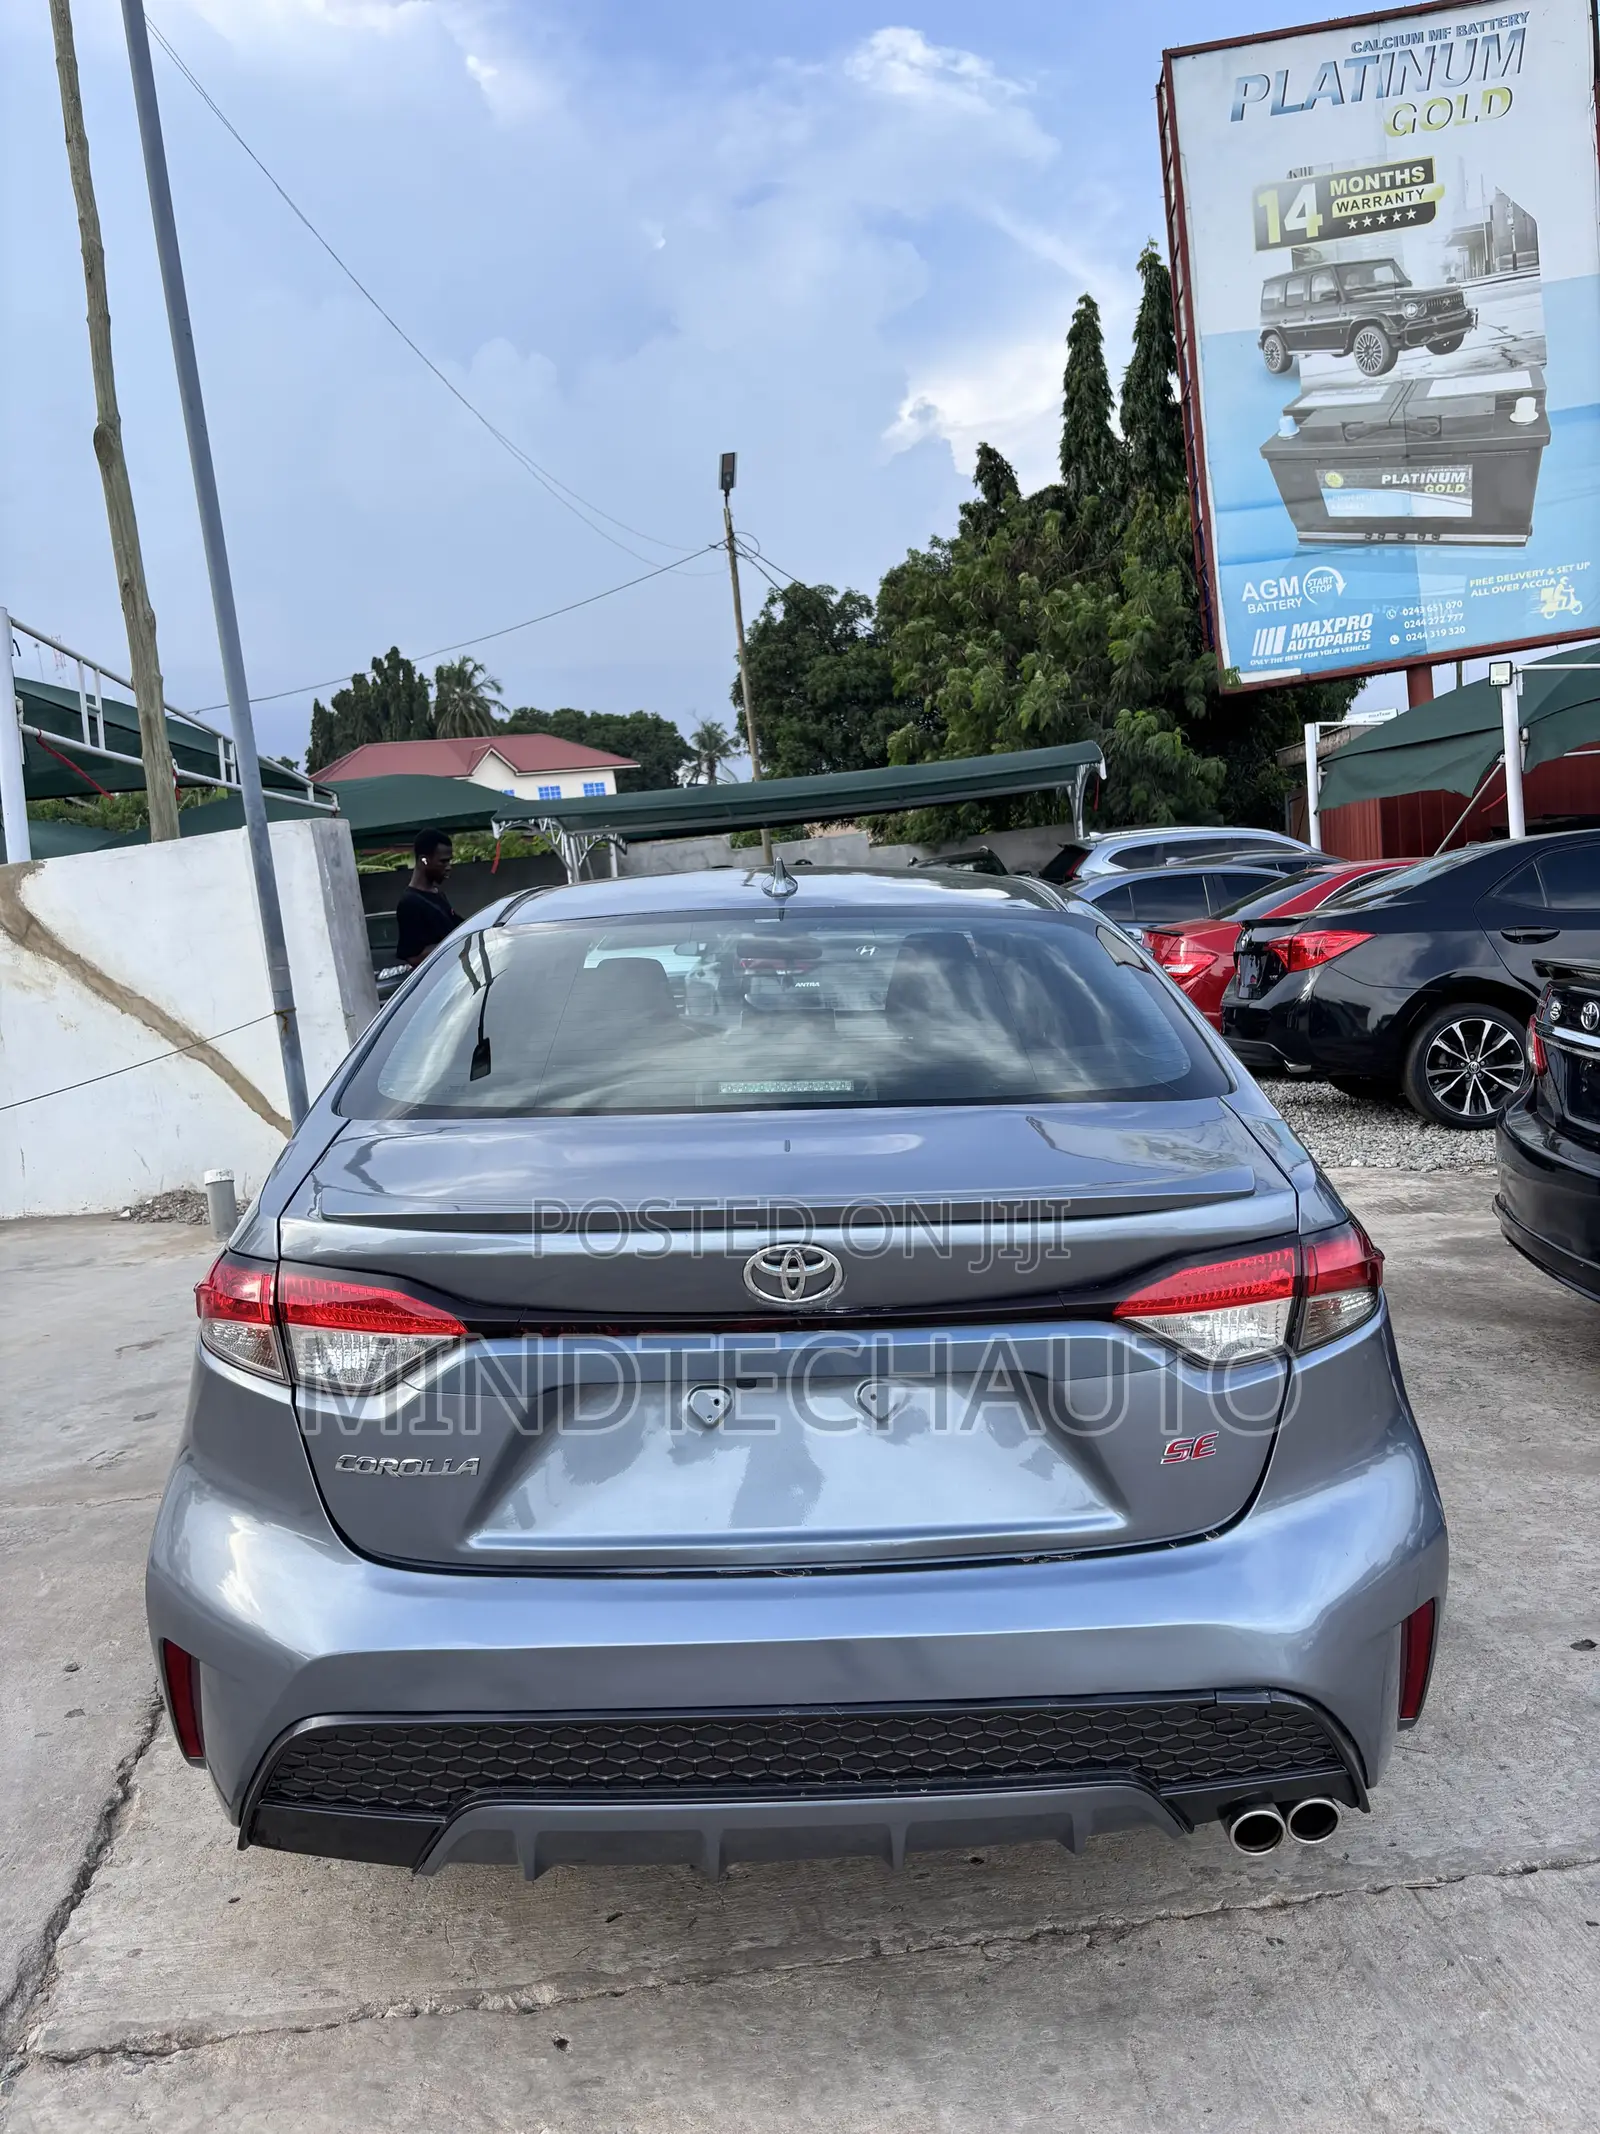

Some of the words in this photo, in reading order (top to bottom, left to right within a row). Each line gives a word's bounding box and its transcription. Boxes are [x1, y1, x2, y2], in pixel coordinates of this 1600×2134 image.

[1351, 31, 1424, 53] CALCIUM
[1428, 27, 1451, 42] MF
[1456, 11, 1530, 37] BATTERY
[1230, 28, 1526, 123] PLATINUM
[1384, 86, 1513, 138] GOLD
[1330, 166, 1426, 196] MONTHS
[1336, 188, 1425, 213] WARRANTY
[1257, 183, 1323, 244] 14
[1381, 472, 1466, 485] PLATINUM
[1424, 483, 1466, 494] GOLD
[1307, 575, 1334, 588] START
[1469, 577, 1494, 588] FREE
[1497, 568, 1545, 583] DELIVERY
[1557, 564, 1574, 575] SET
[1577, 561, 1591, 571] UP
[1241, 575, 1300, 602] AGM
[1309, 584, 1333, 595] STOP
[1471, 588, 1490, 598] ALL
[1492, 583, 1519, 595] OVER
[1521, 578, 1557, 590] ACCRA
[1247, 597, 1303, 614] BATTERY
[1402, 605, 1425, 616] 0243
[1427, 603, 1443, 613] 651
[1445, 600, 1463, 610] 070
[1291, 612, 1373, 640] MAXPRO
[1404, 618, 1426, 630] 0244
[1406, 631, 1428, 643] 0244
[1430, 628, 1447, 639] 319
[1448, 625, 1466, 636] 320
[1286, 629, 1372, 653] AUTOPARTS
[1250, 656, 1269, 666] ONLY
[1270, 655, 1284, 665] THE
[1284, 652, 1303, 662] BEST
[1303, 650, 1319, 659] FOR
[1319, 647, 1340, 657] YOUR
[1340, 643, 1372, 655] VEHICLE
[1160, 1430, 1220, 1464] SE
[334, 1454, 481, 1478] COROLLA
